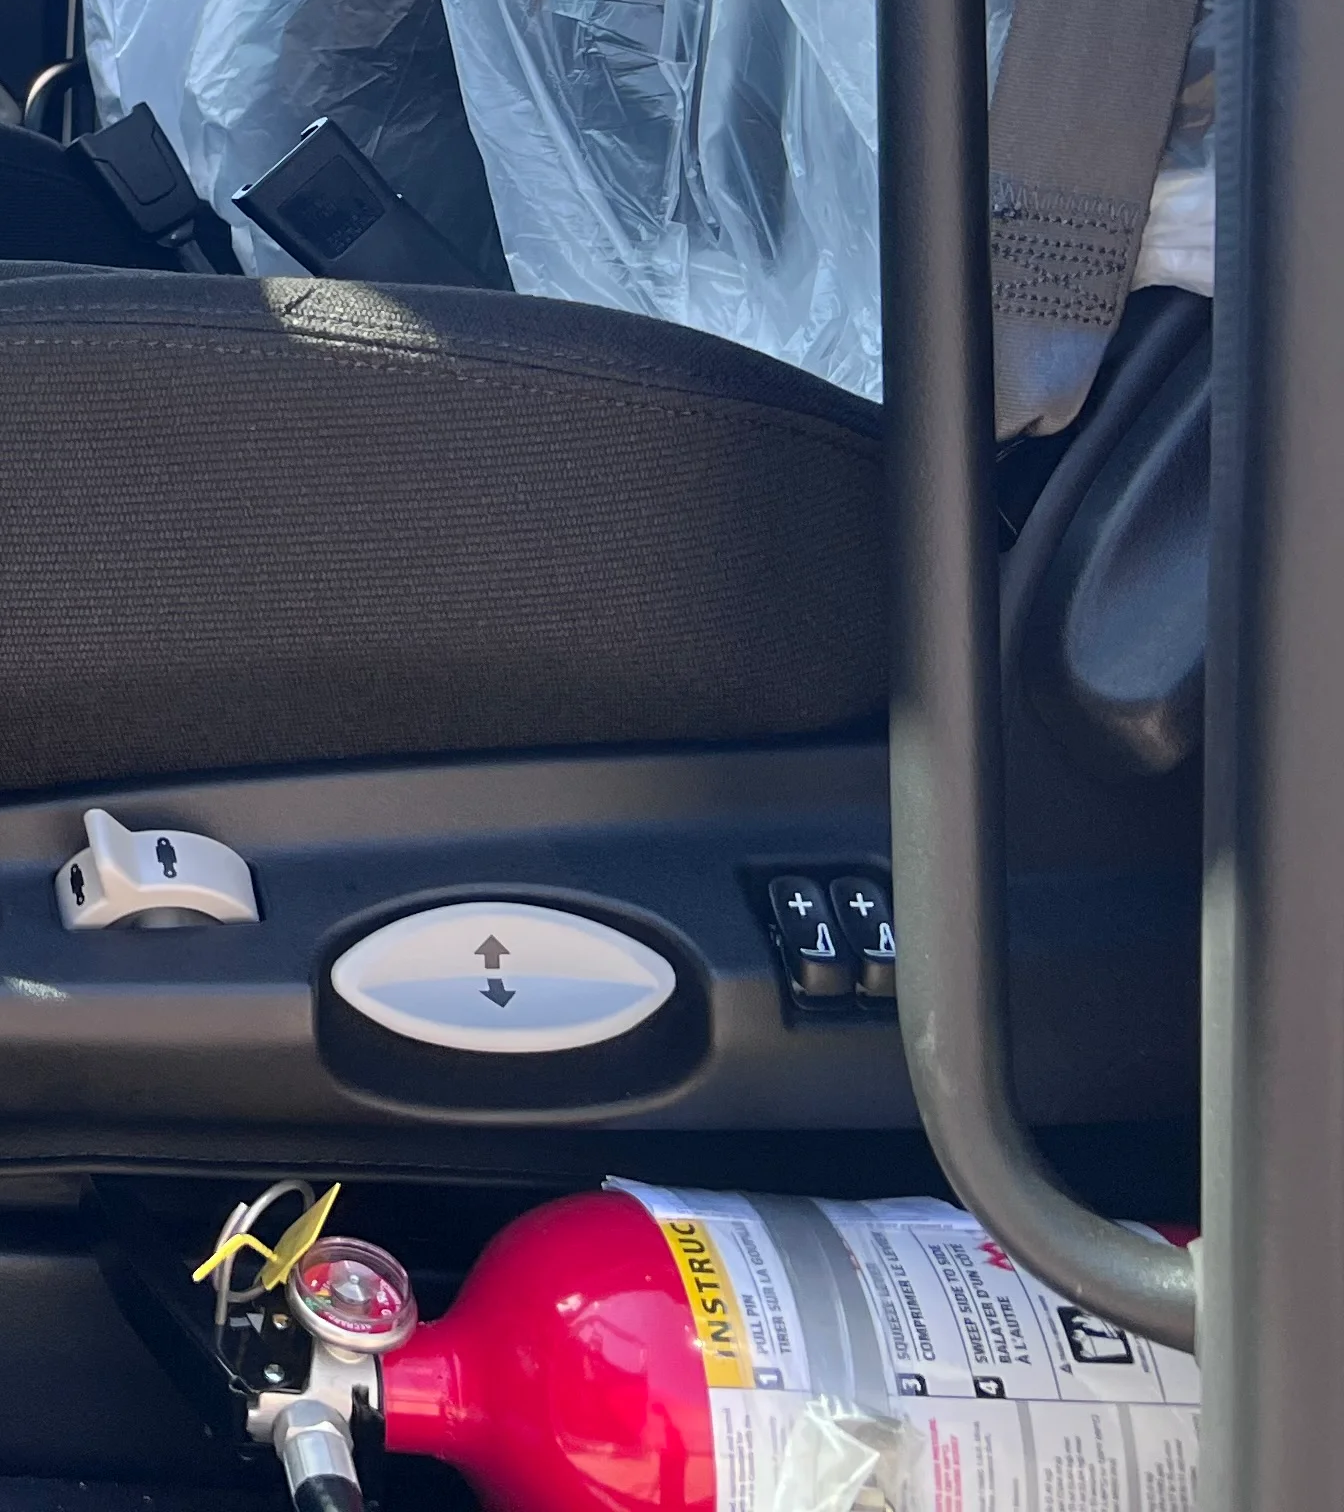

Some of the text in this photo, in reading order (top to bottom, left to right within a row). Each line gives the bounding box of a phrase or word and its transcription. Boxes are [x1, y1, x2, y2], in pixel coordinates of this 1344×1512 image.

[756, 1268, 772, 1284] LA
[890, 1263, 907, 1277] LE
[741, 1293, 770, 1355] PULL PIN
[763, 1286, 783, 1312] SUR
[898, 1279, 936, 1362] COMPRIMER
[928, 1243, 989, 1364] SWEEP SIDE TO SIDE
[772, 1315, 792, 1355] TIRER
[981, 1302, 1013, 1365] BALAYER
